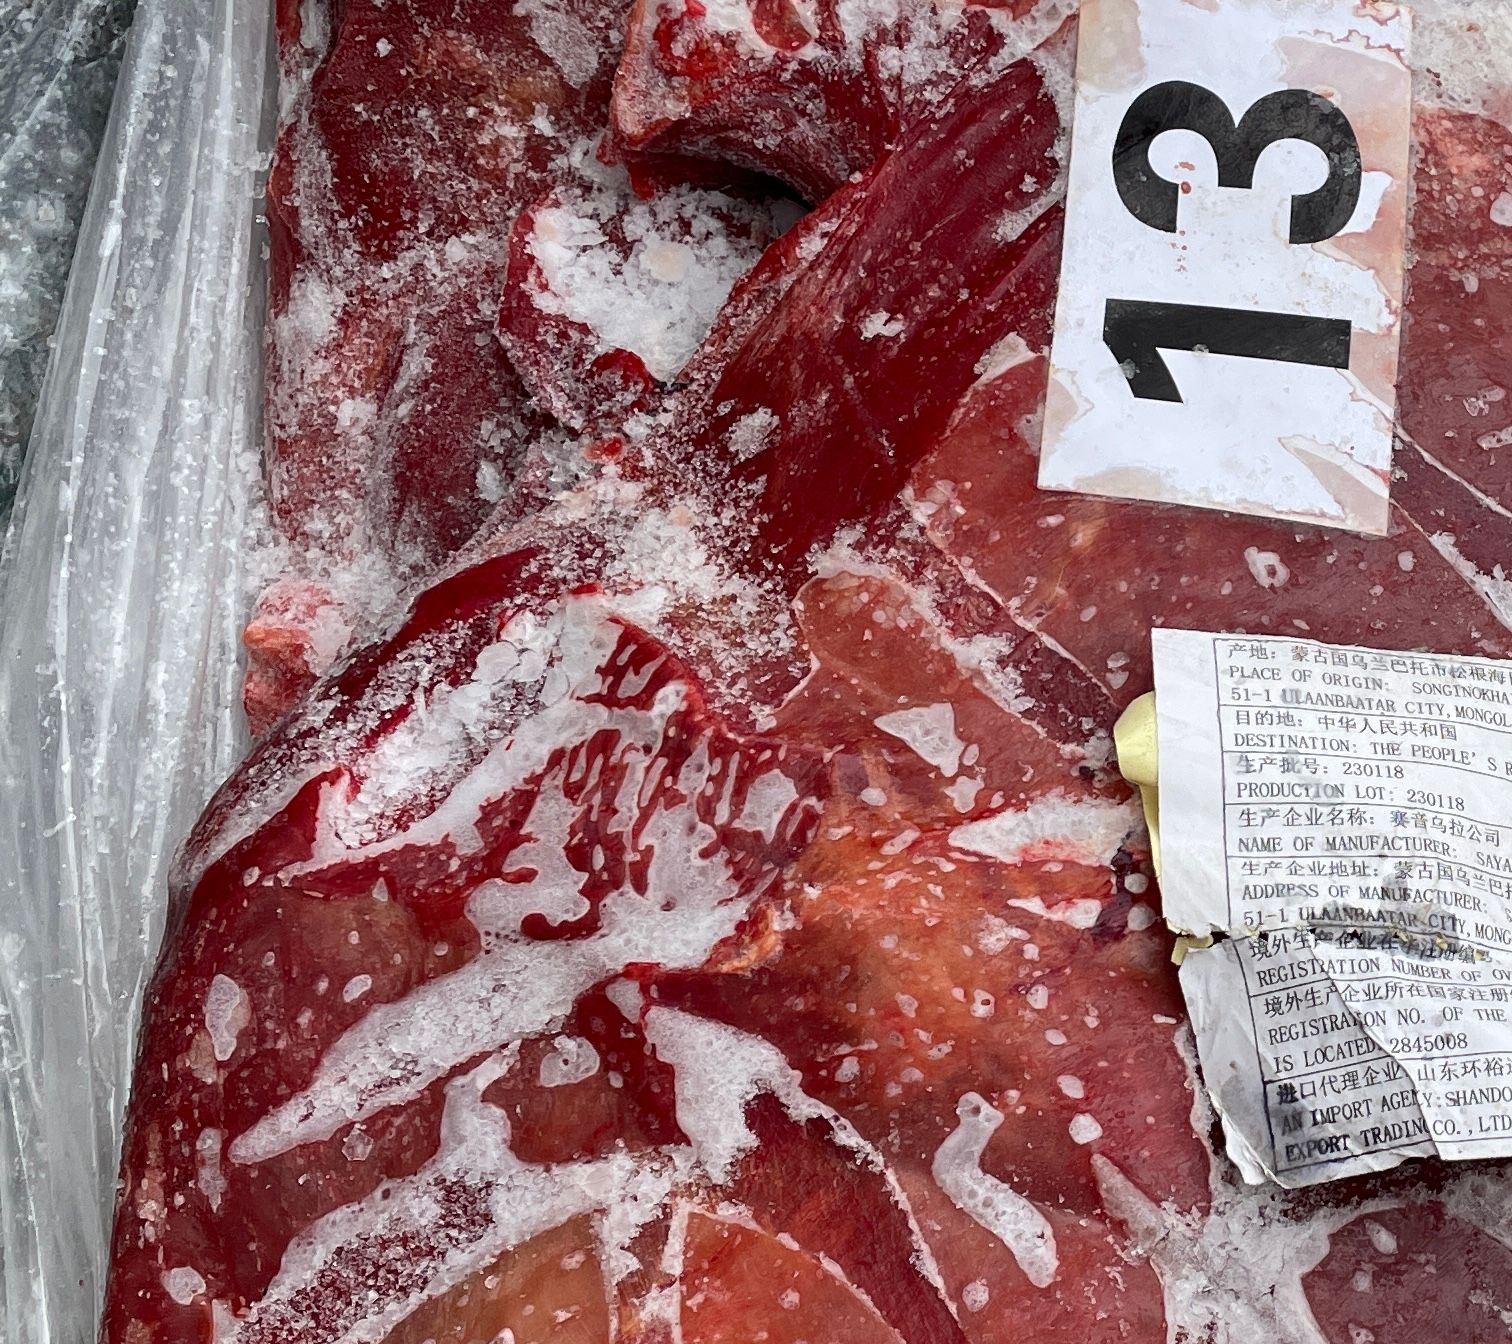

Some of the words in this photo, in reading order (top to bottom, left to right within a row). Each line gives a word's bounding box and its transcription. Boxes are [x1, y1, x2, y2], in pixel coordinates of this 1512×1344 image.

[1102, 80, 1363, 404] 13
[1229, 666, 1282, 681] PLACE
[1292, 668, 1313, 683] OF
[1322, 671, 1390, 692] ORIGIN:
[1231, 687, 1271, 702] 51-1
[1281, 688, 1397, 714] ULAANBAATAR
[1234, 732, 1358, 753] DESTINATION:
[1371, 741, 1401, 756] THE
[1237, 782, 1345, 800] PRODUCTION
[1355, 785, 1395, 802] LOT:
[1406, 788, 1466, 812] 230118
[1238, 837, 1282, 853] NAME
[1293, 837, 1315, 852] OF
[1325, 835, 1458, 857] MANUFACTURER:
[1242, 884, 1319, 900] ADDRESS
[1328, 885, 1349, 898] OF
[1359, 886, 1487, 914] MANUFACTURER:
[1244, 907, 1288, 926] 51-1
[1391, 957, 1452, 981] NUMBER
[1461, 970, 1482, 984] OF
[1397, 1007, 1426, 1025] NO.
[1442, 1006, 1463, 1022] OF
[1473, 1008, 1507, 1023] THE
[1274, 1054, 1295, 1074] IS
[1311, 1098, 1374, 1128] IMPORT
[1285, 1133, 1350, 1163] EXPORT
